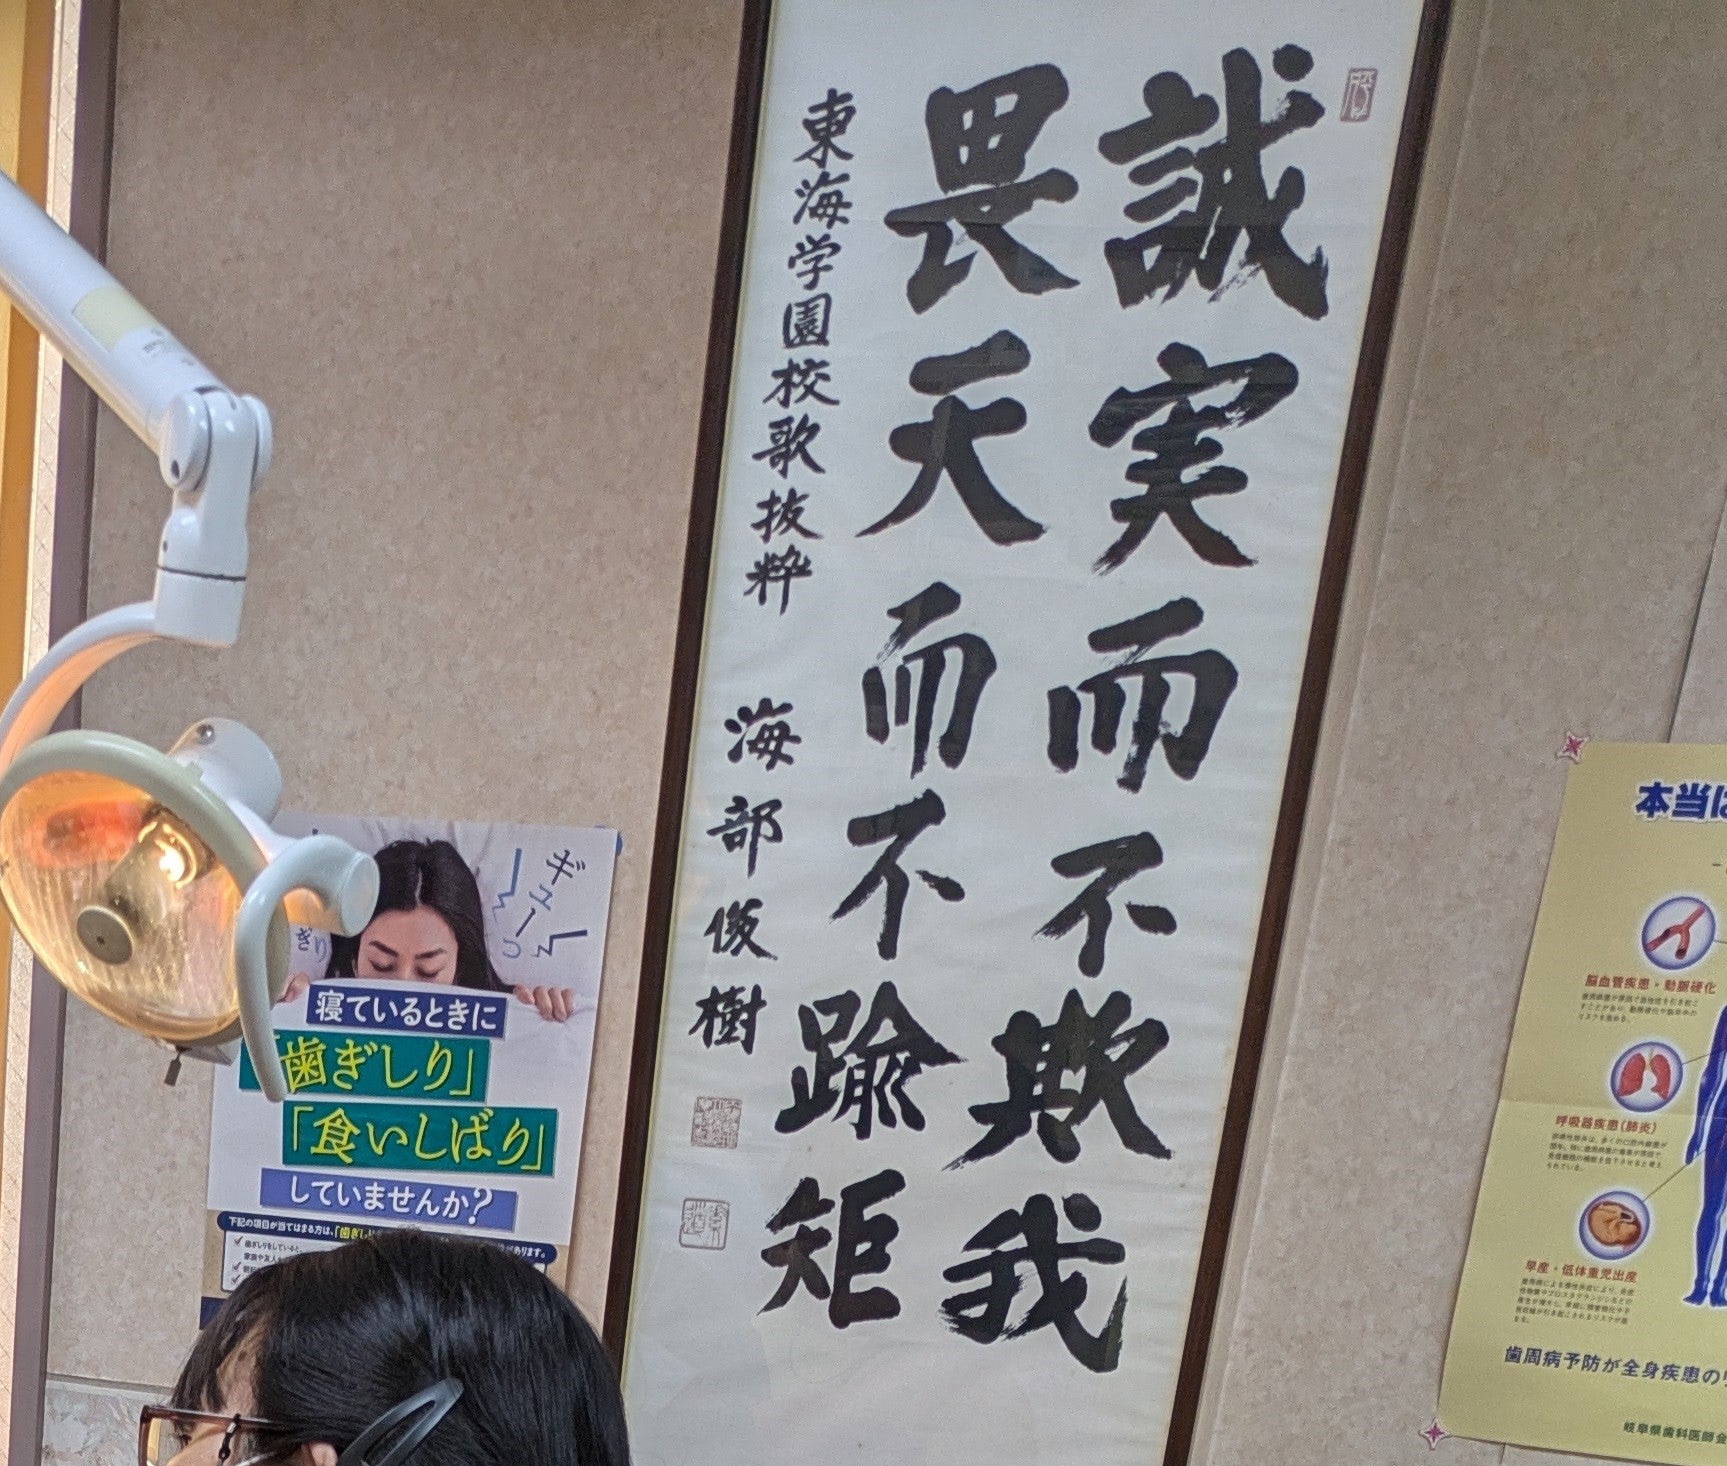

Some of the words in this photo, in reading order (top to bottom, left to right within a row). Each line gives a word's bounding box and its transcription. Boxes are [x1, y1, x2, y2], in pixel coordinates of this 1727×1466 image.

[939, 44, 1329, 1375] 誠実而不欺我
[314, 990, 498, 1031] 寝ているときに
[273, 1032, 475, 1096] 歯ぎしり」
[291, 1106, 545, 1171] 「食いしばり」
[289, 1174, 493, 1225] していませんか？
[1504, 1346, 1727, 1388] 歯周病予防が全身疾患の
